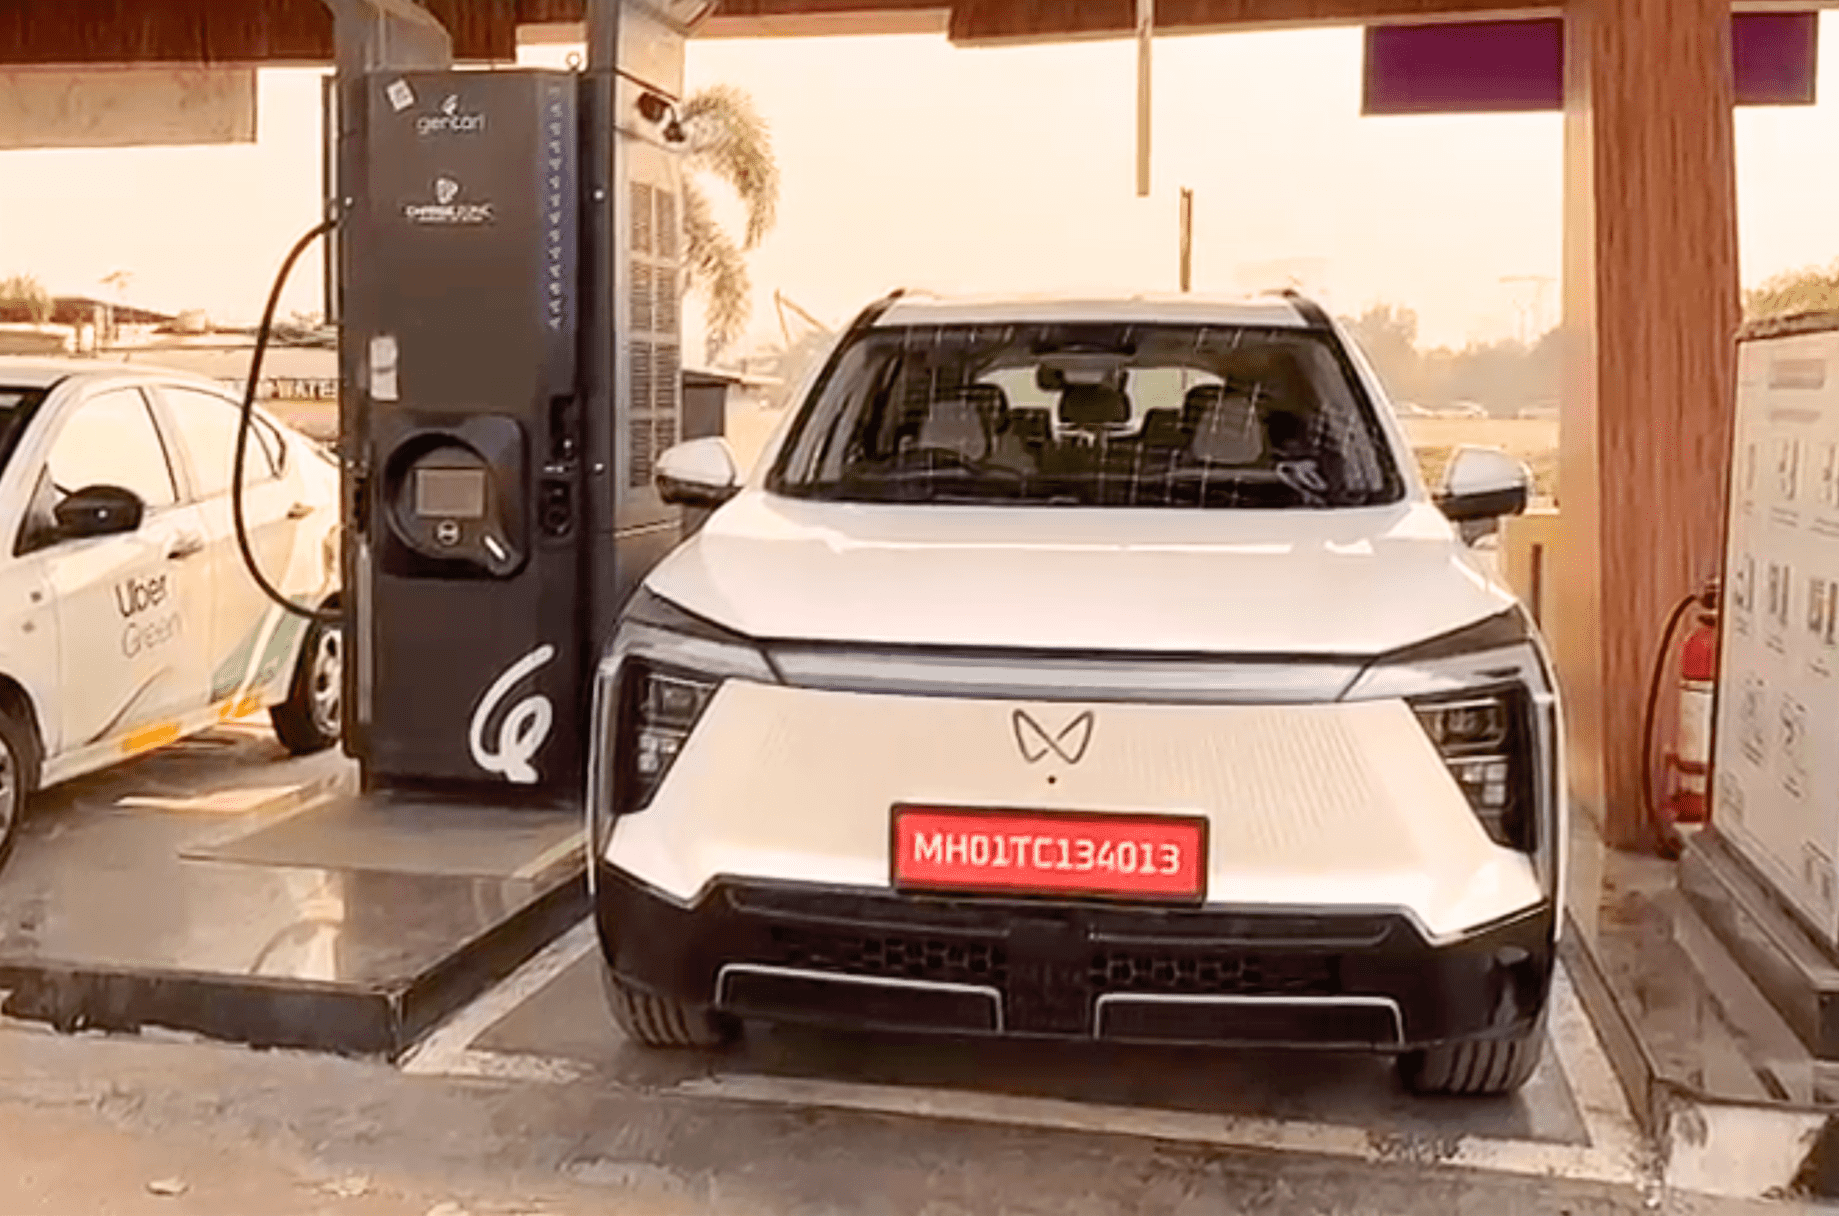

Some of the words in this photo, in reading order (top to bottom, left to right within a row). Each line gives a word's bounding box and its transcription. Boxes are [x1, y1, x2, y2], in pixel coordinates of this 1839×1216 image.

[115, 574, 166, 618] Uber
[121, 611, 182, 659] Green
[913, 831, 1181, 875] MH01TC134013
